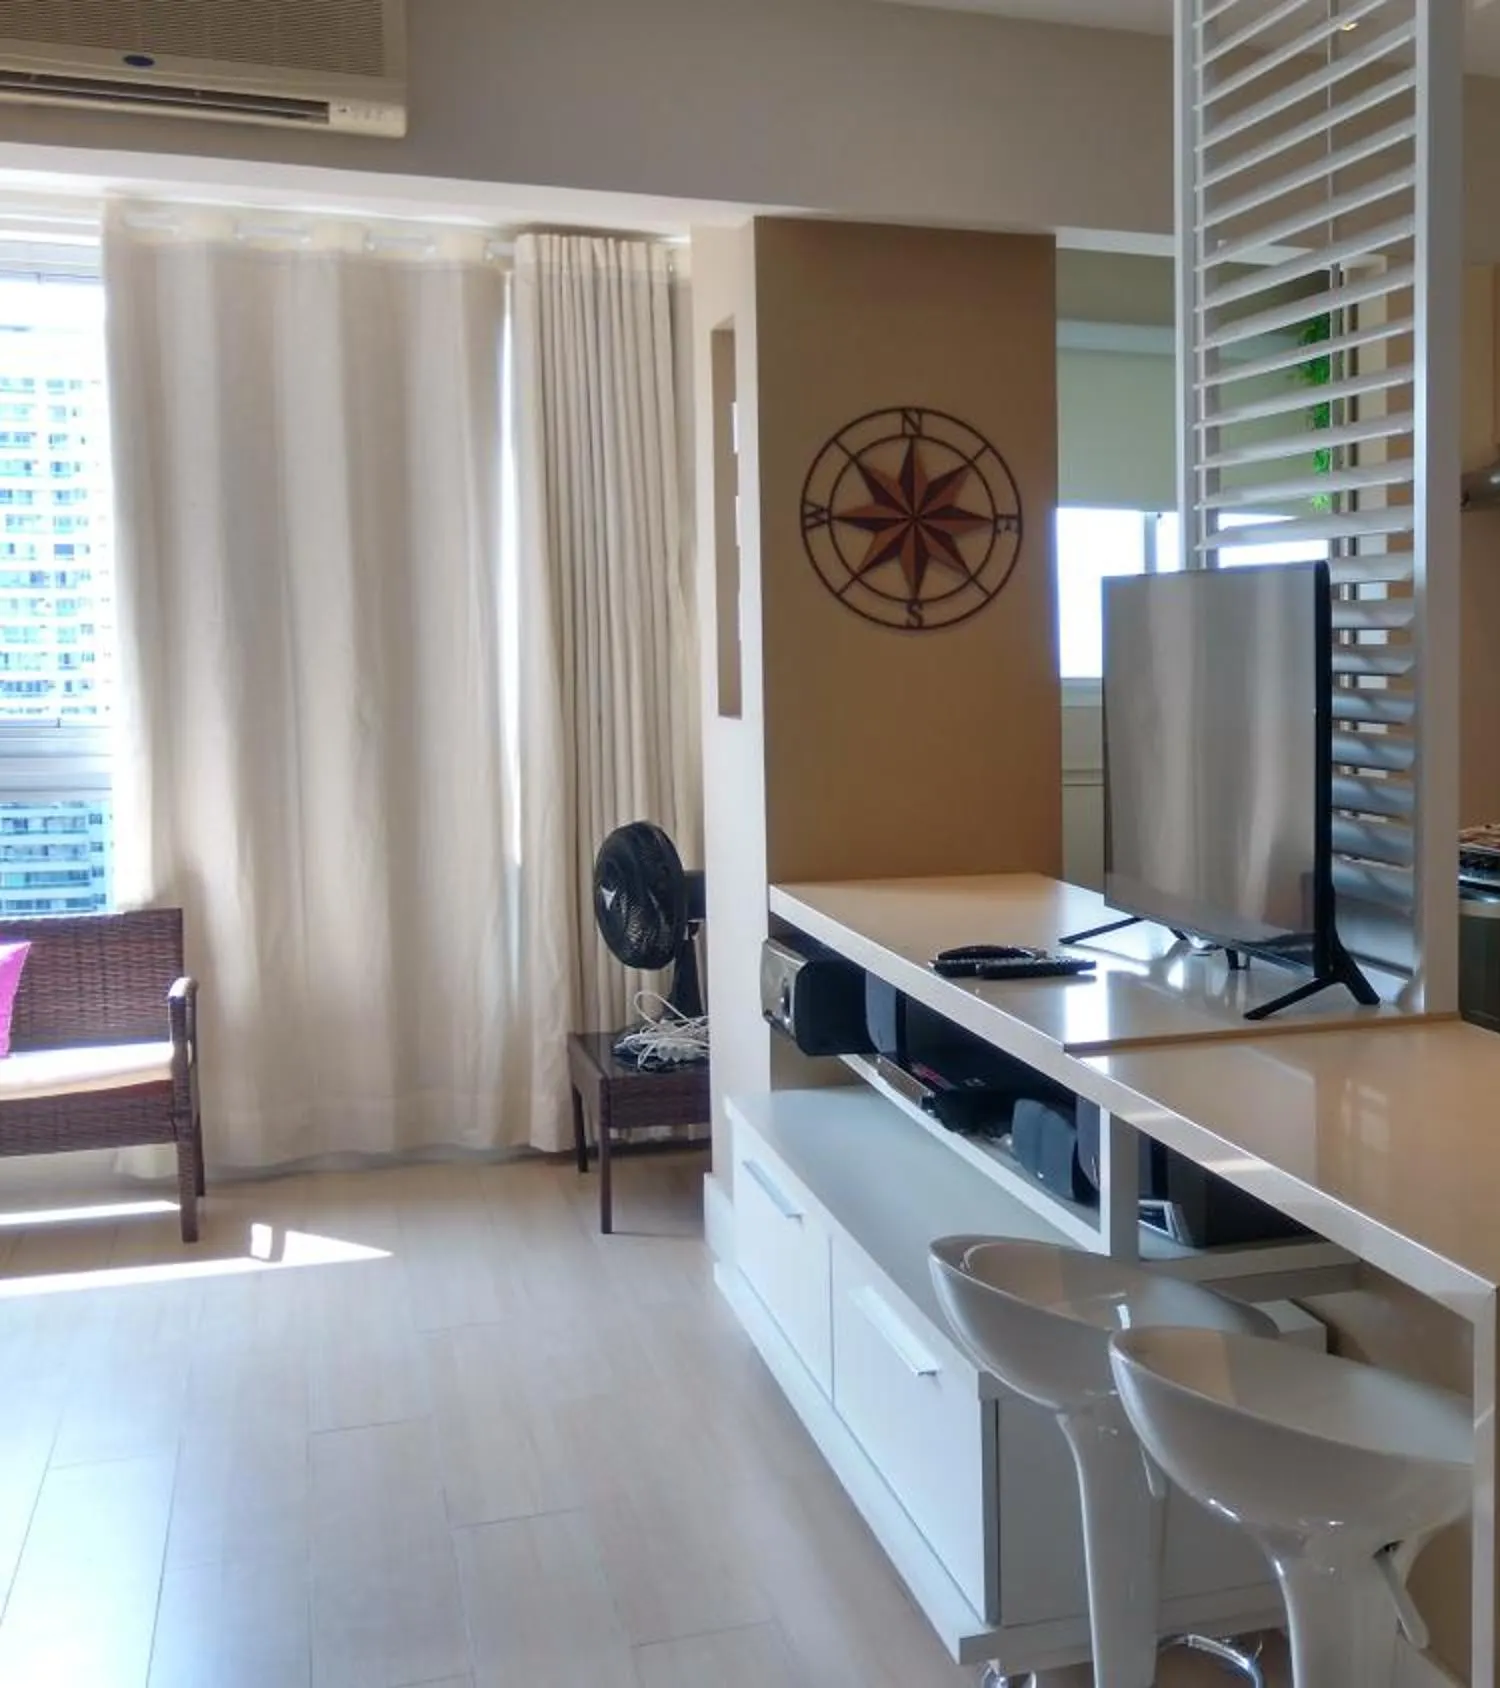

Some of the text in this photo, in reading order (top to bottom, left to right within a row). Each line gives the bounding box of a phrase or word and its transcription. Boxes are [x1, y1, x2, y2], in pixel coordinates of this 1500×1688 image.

[902, 410, 923, 436] N
[803, 503, 827, 529] W
[906, 604, 925, 628] S
